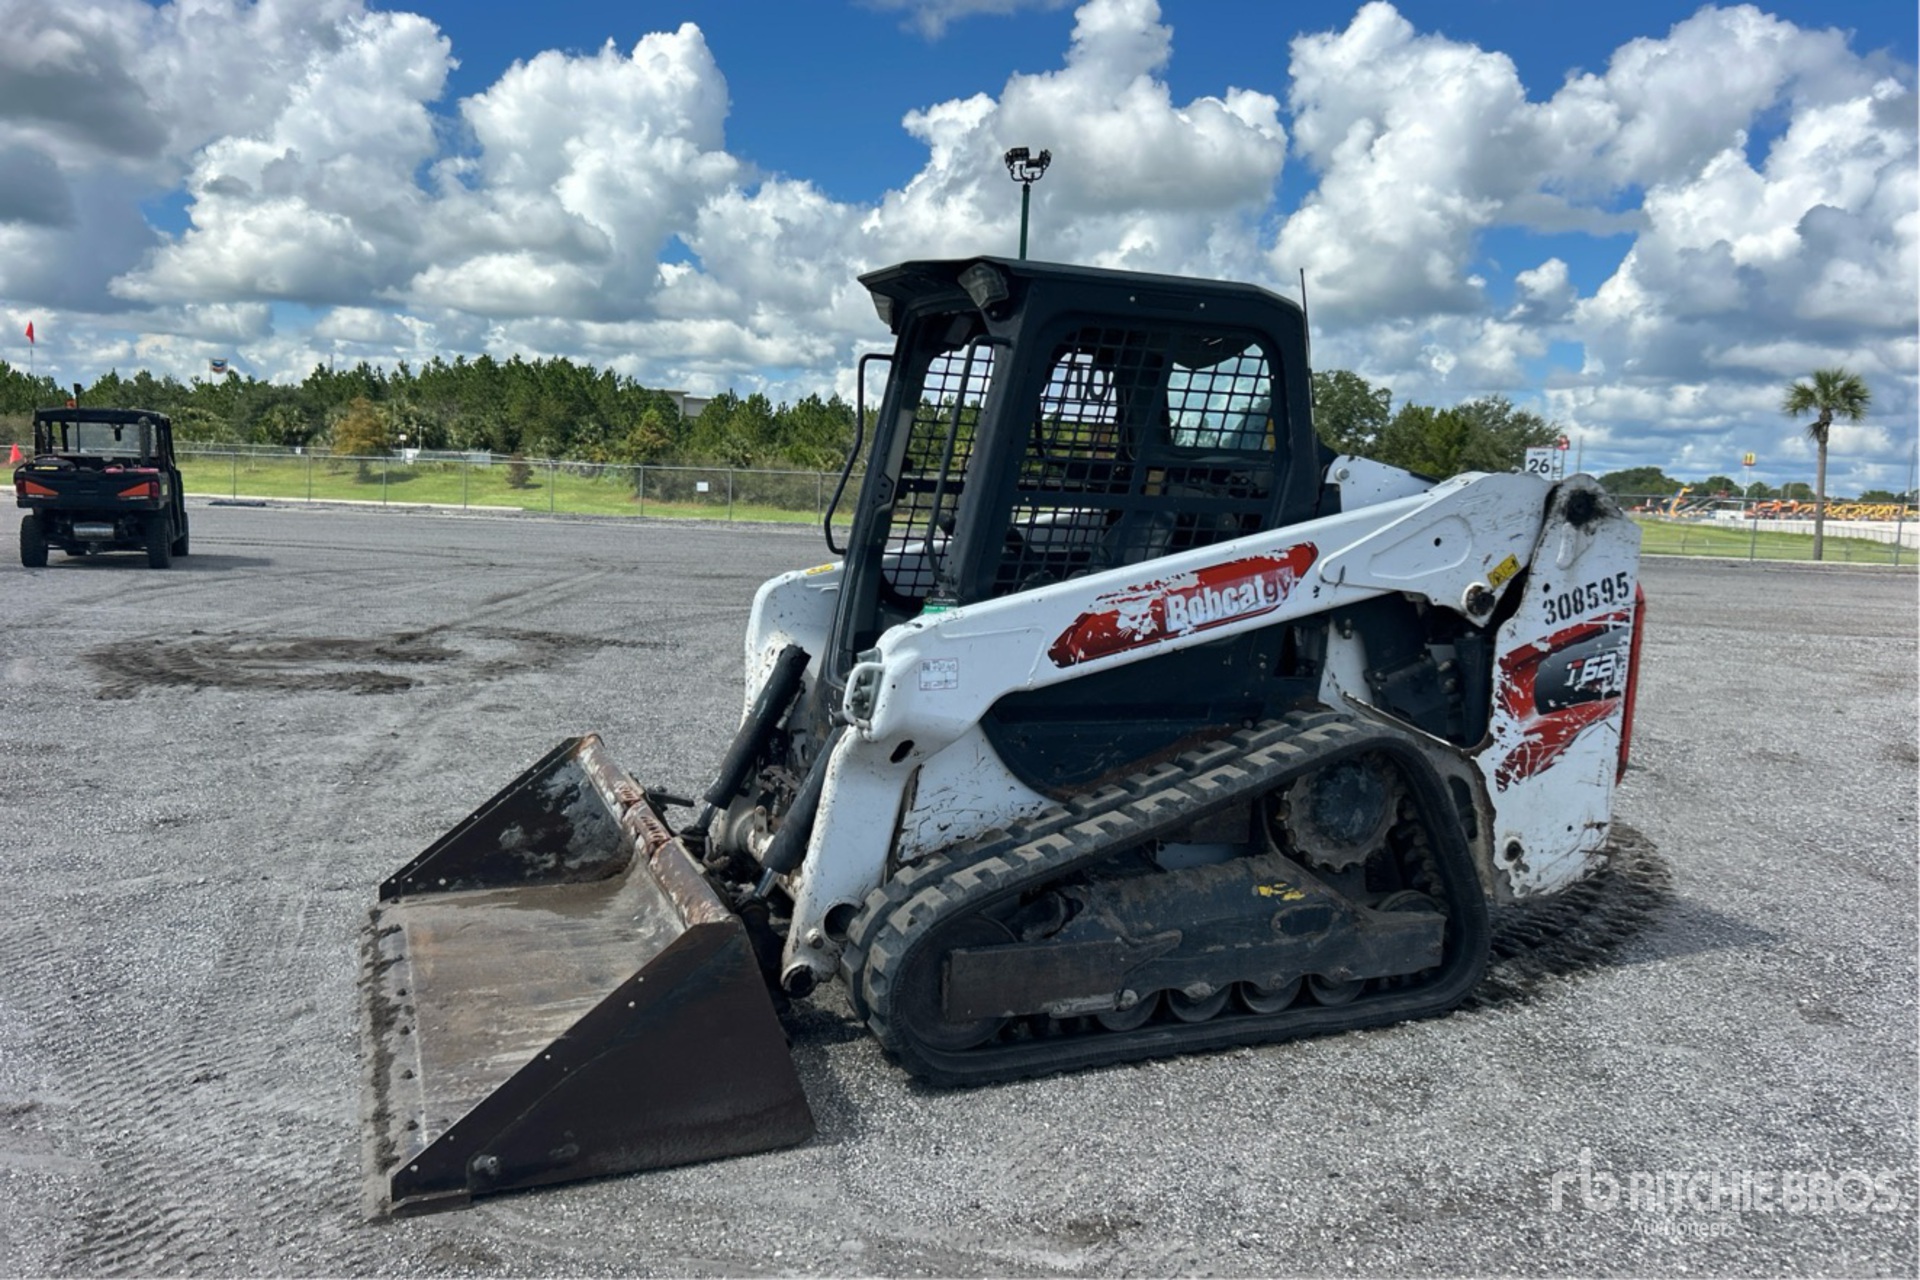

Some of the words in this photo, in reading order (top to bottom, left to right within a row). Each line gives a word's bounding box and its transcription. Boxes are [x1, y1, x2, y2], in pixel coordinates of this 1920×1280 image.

[1528, 458, 1550, 473] 26
[1166, 575, 1267, 632] Bobcat
[1542, 571, 1629, 625] 308595
